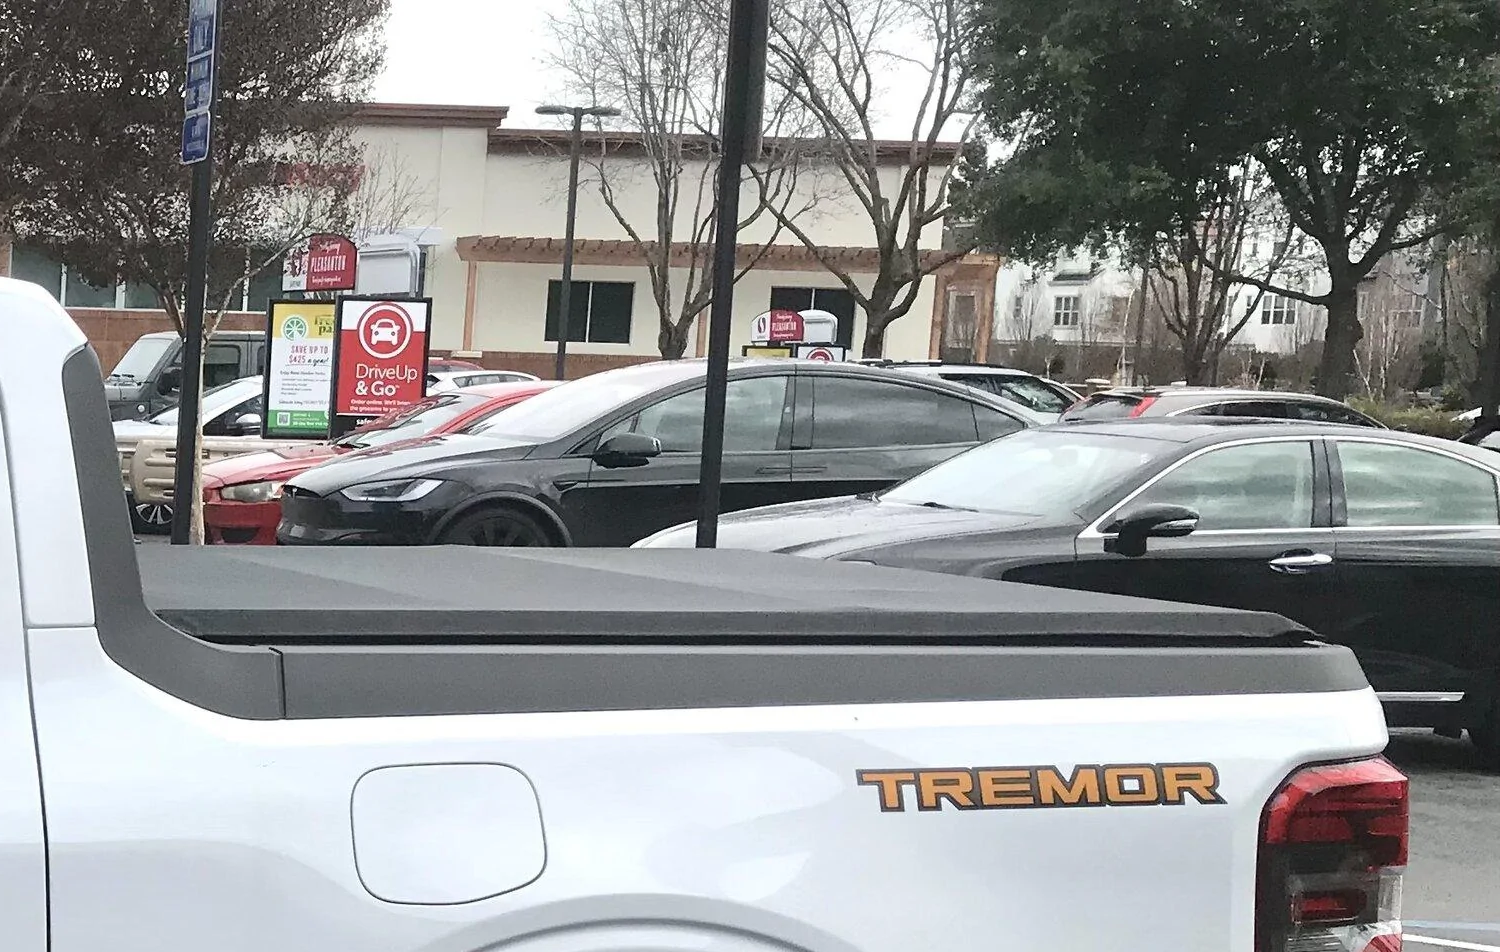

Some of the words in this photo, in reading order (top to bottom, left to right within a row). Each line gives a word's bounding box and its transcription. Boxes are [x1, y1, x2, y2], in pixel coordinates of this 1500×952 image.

[318, 326, 332, 336] pa
[291, 345, 308, 354] SAVE
[309, 345, 319, 354] UP
[319, 345, 329, 354] TO
[288, 354, 306, 364] $425
[355, 363, 417, 384] DriveUp
[355, 380, 368, 396] &
[856, 762, 1228, 812] TREMOR
